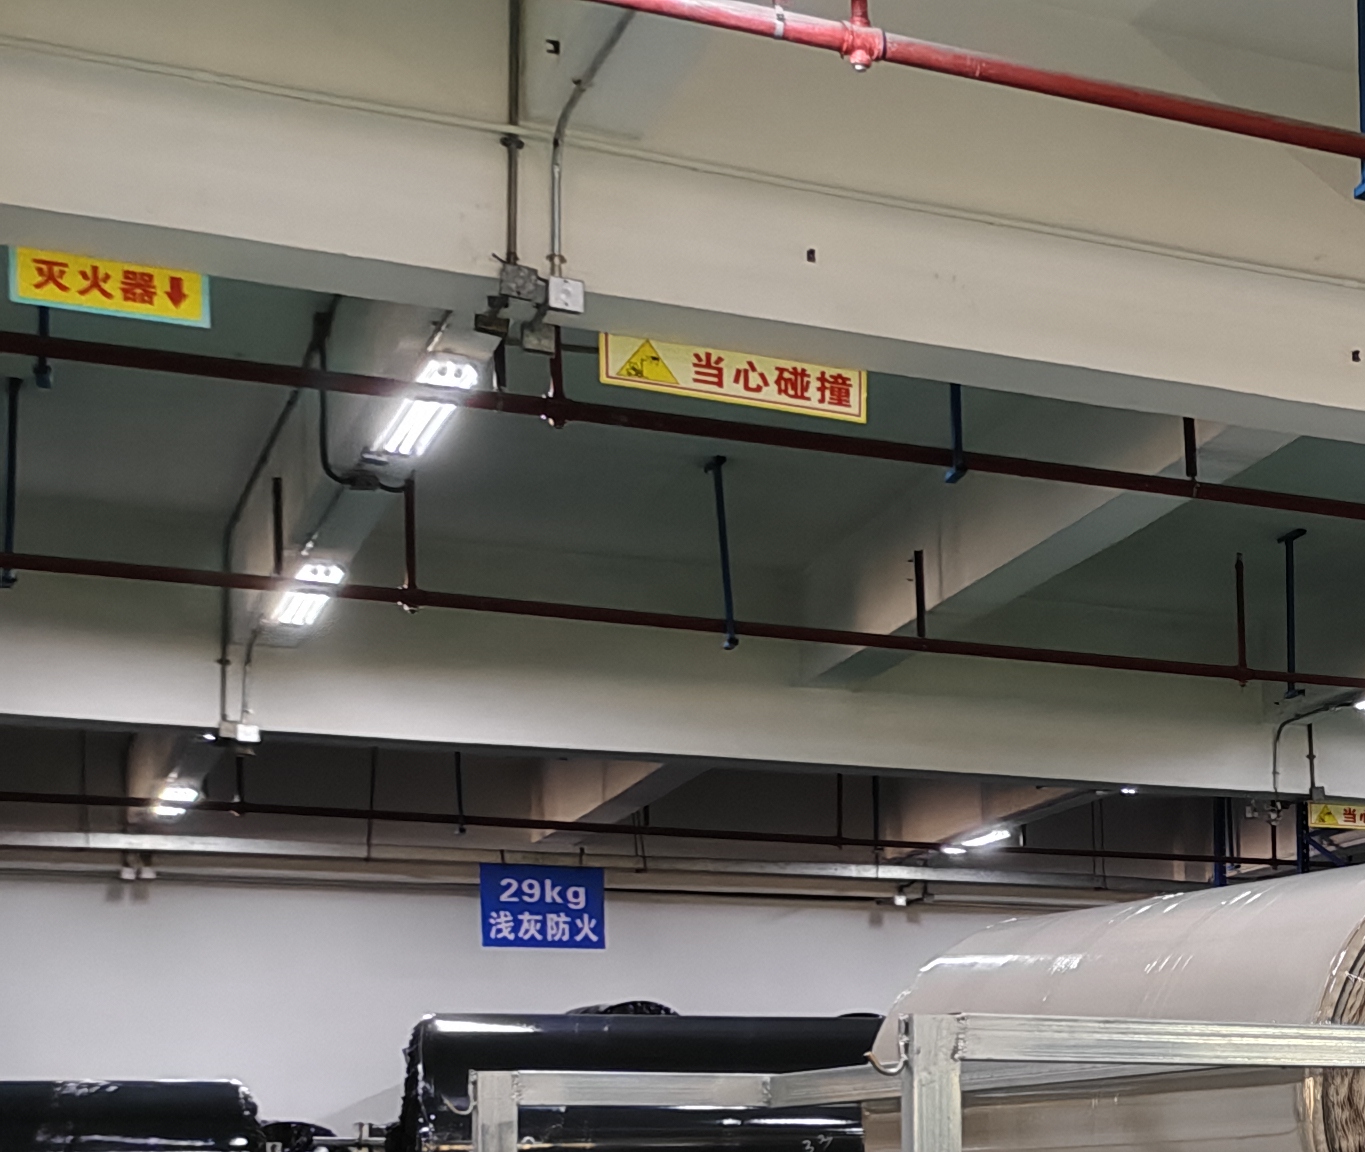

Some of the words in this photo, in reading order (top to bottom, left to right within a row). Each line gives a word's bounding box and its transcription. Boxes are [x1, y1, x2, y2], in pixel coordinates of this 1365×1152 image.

[32, 258, 157, 306] 灭火器
[692, 351, 853, 408] 当心碰撞
[499, 878, 587, 910] 29kg
[488, 911, 600, 942] 浅灰防火
